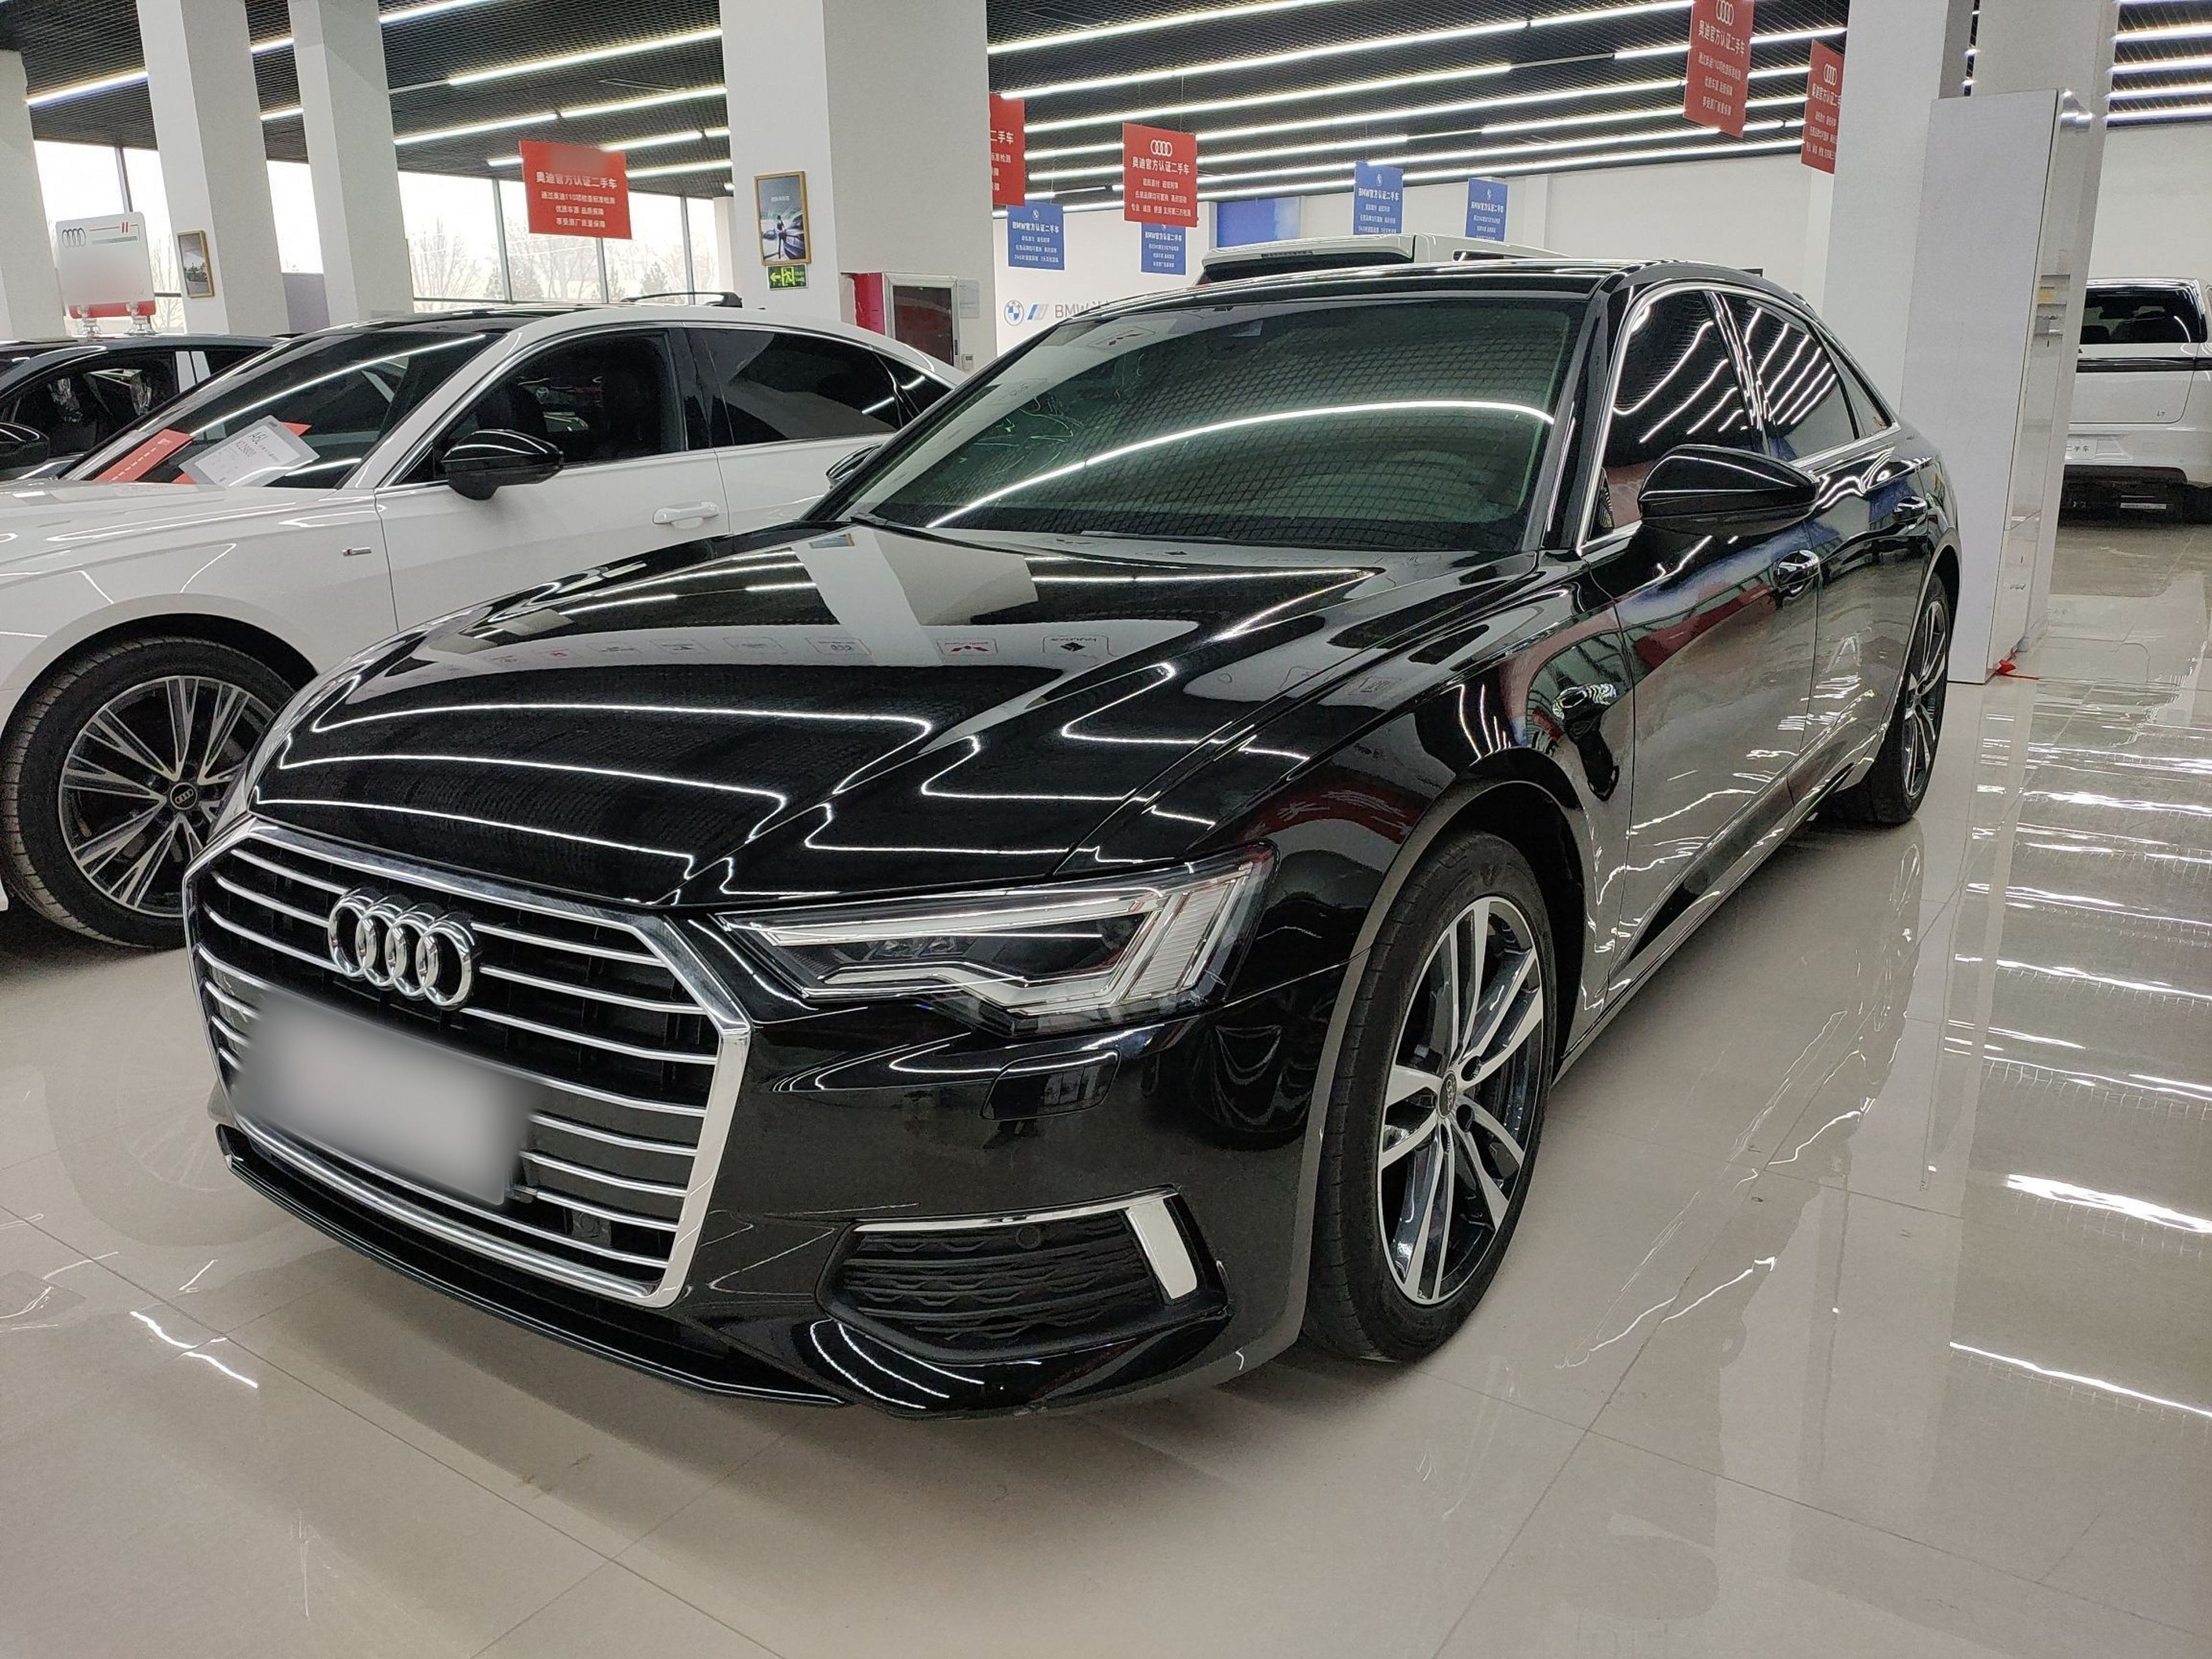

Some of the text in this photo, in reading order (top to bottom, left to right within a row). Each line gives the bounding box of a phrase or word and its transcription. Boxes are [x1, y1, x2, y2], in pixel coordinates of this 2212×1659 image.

[1132, 156, 1190, 175] 奥迪官方认证二手车
[536, 171, 618, 190] 奥迪官方认证二手车
